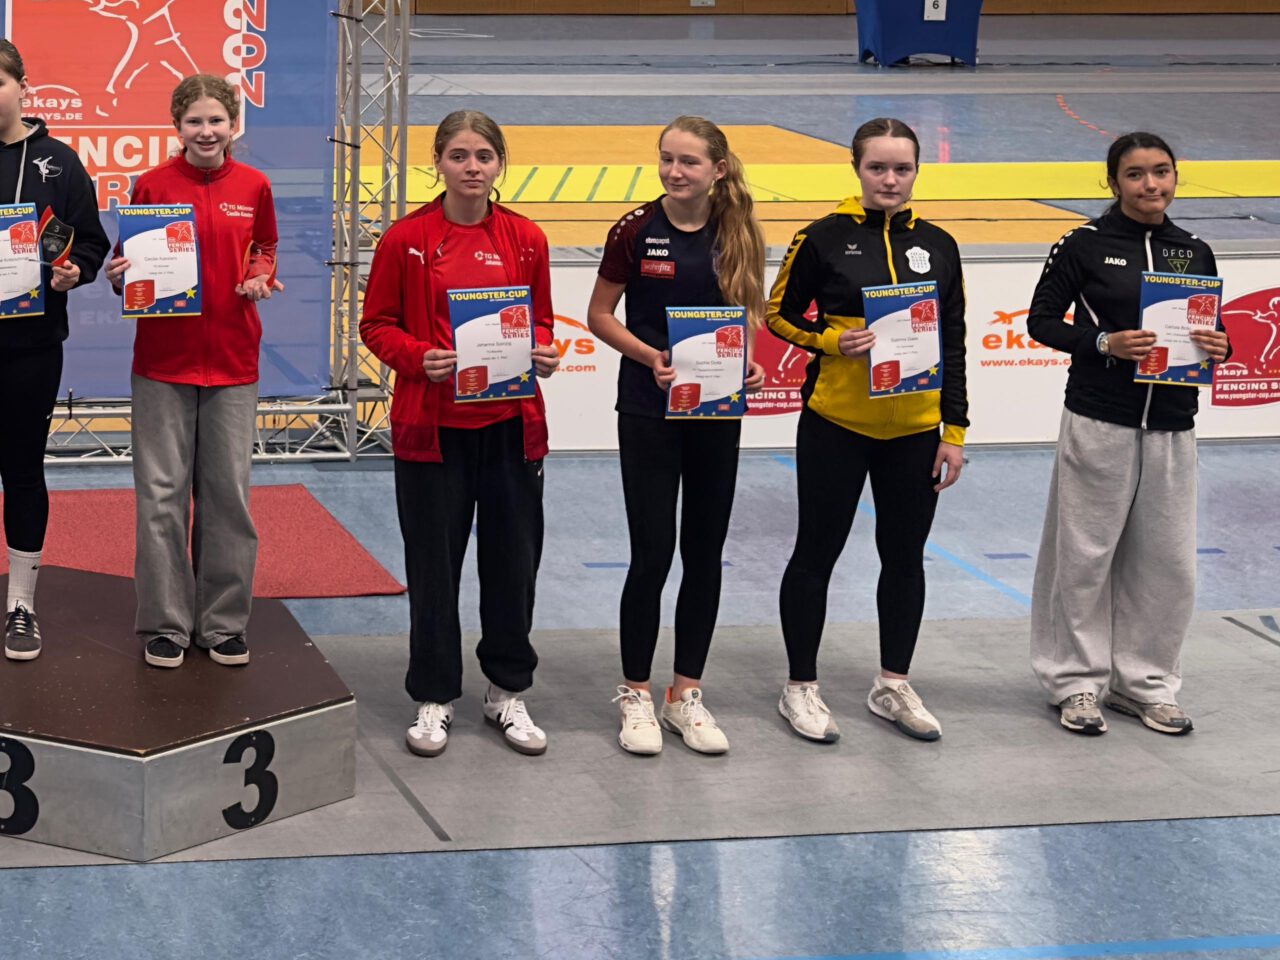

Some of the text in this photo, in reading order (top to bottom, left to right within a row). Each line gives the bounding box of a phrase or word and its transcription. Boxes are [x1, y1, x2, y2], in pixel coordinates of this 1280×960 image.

[932, 0, 940, 10] 6
[118, 208, 192, 216] YOUNGSTER-CUP
[54, 225, 60, 233] 3
[646, 248, 669, 257] JAKO
[1104, 256, 1127, 266] JAKO
[1144, 275, 1221, 288] YOUNGSTER-CUP
[449, 290, 528, 301] YOUNGSTER-CUP
[864, 285, 935, 299] YOUNGSTER-CUP
[668, 310, 743, 319] YOUNGSTER-CUP
[1216, 368, 1248, 376] ekays
[1215, 382, 1268, 391] FENCING
[220, 728, 280, 831] 3
